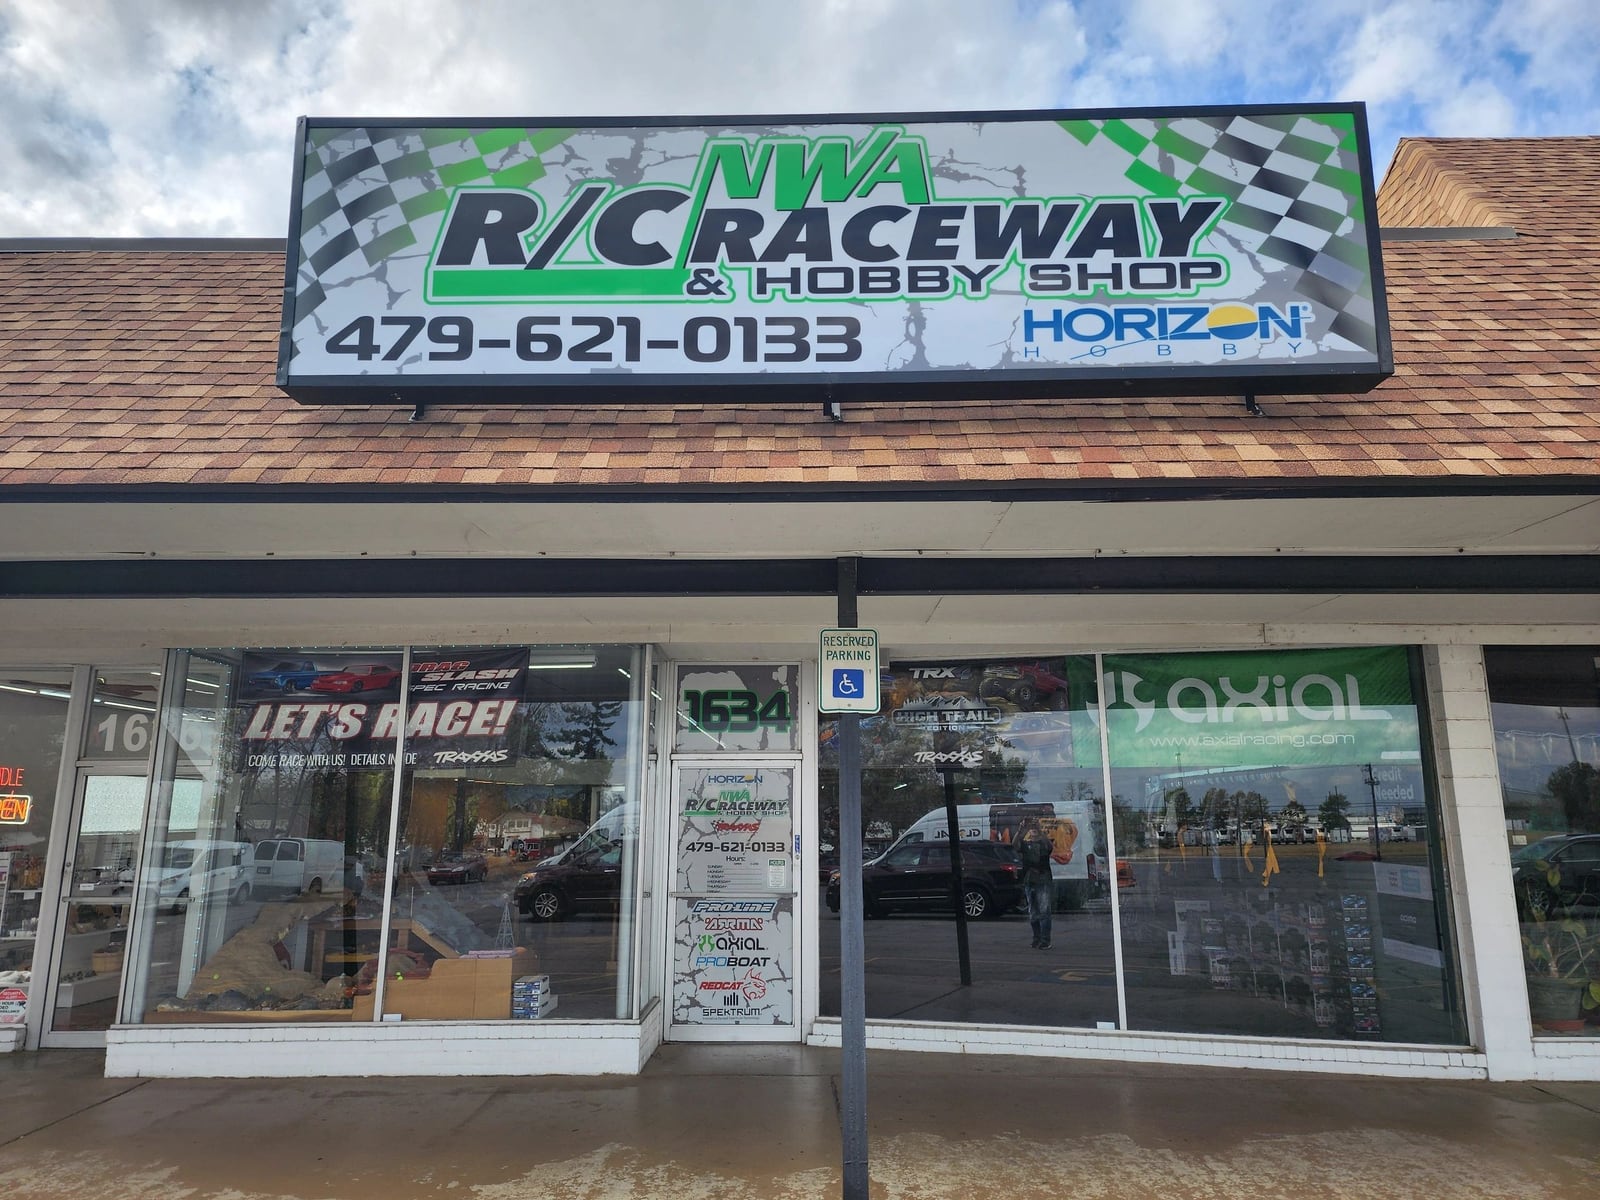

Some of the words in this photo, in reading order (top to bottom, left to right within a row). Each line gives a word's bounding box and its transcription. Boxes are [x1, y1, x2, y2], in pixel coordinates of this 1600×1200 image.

[690, 131, 930, 213] NWA
[436, 187, 692, 270] R/C
[690, 202, 1228, 263] RACEWAY
[686, 268, 726, 295] &
[757, 264, 1000, 294] HOBBY
[1029, 261, 1222, 290] SHOP
[1024, 305, 1303, 342] HORIZON
[325, 315, 862, 362] 479-621-0133
[824, 636, 874, 646] RESERVED
[826, 651, 870, 660] PARKING
[421, 669, 519, 681] SLASH
[409, 684, 447, 692] PEC
[452, 682, 511, 691] RACING
[684, 690, 790, 733] 1634
[896, 711, 937, 723] HIGH
[941, 710, 995, 722] TRAIL
[243, 703, 367, 738] LET'S
[370, 700, 517, 737] RACE!
[1149, 732, 1355, 748] www.axialracing.com
[249, 755, 277, 767] COME
[279, 755, 305, 767] RACE
[306, 755, 328, 767] WITH
[331, 754, 346, 766] US!
[351, 754, 385, 766] DETAILS
[388, 753, 417, 765] INDE
[433, 749, 508, 763] TRAXXAS
[914, 750, 983, 763] TRAXXAS
[708, 775, 763, 783] HORIZON
[719, 788, 751, 801] NWA
[685, 799, 718, 812] R/C
[719, 801, 787, 811] RACEWAY
[686, 842, 785, 852] 479-621-0133
[700, 982, 743, 990] REDCAT
[703, 1008, 760, 1017] SPEKTRUM
